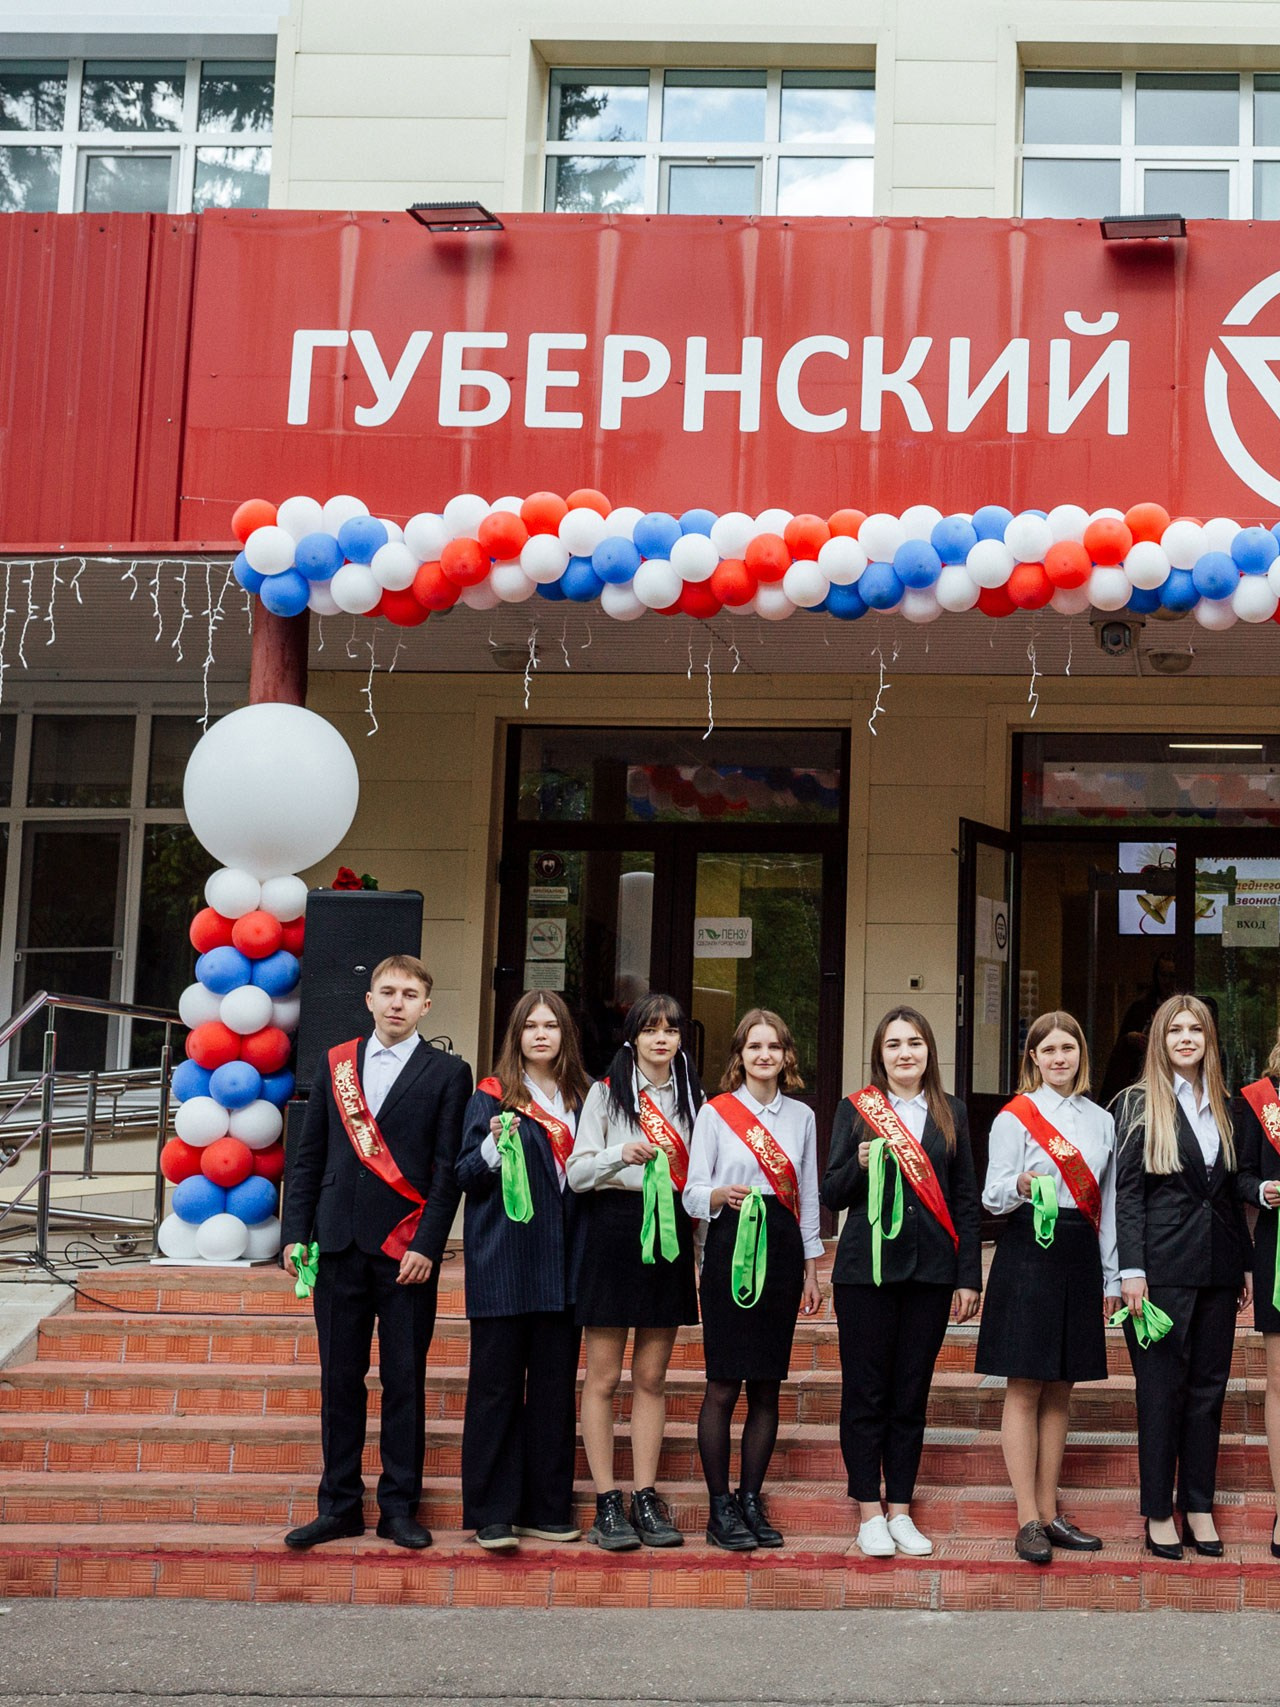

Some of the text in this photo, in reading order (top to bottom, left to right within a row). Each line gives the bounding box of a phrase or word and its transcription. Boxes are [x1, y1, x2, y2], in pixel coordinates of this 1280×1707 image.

[286, 310, 1131, 436] ГУБЕРНСКИЙ
[1236, 920, 1267, 930] ВХОД
[698, 929, 749, 939] Я ПЕНЗУ
